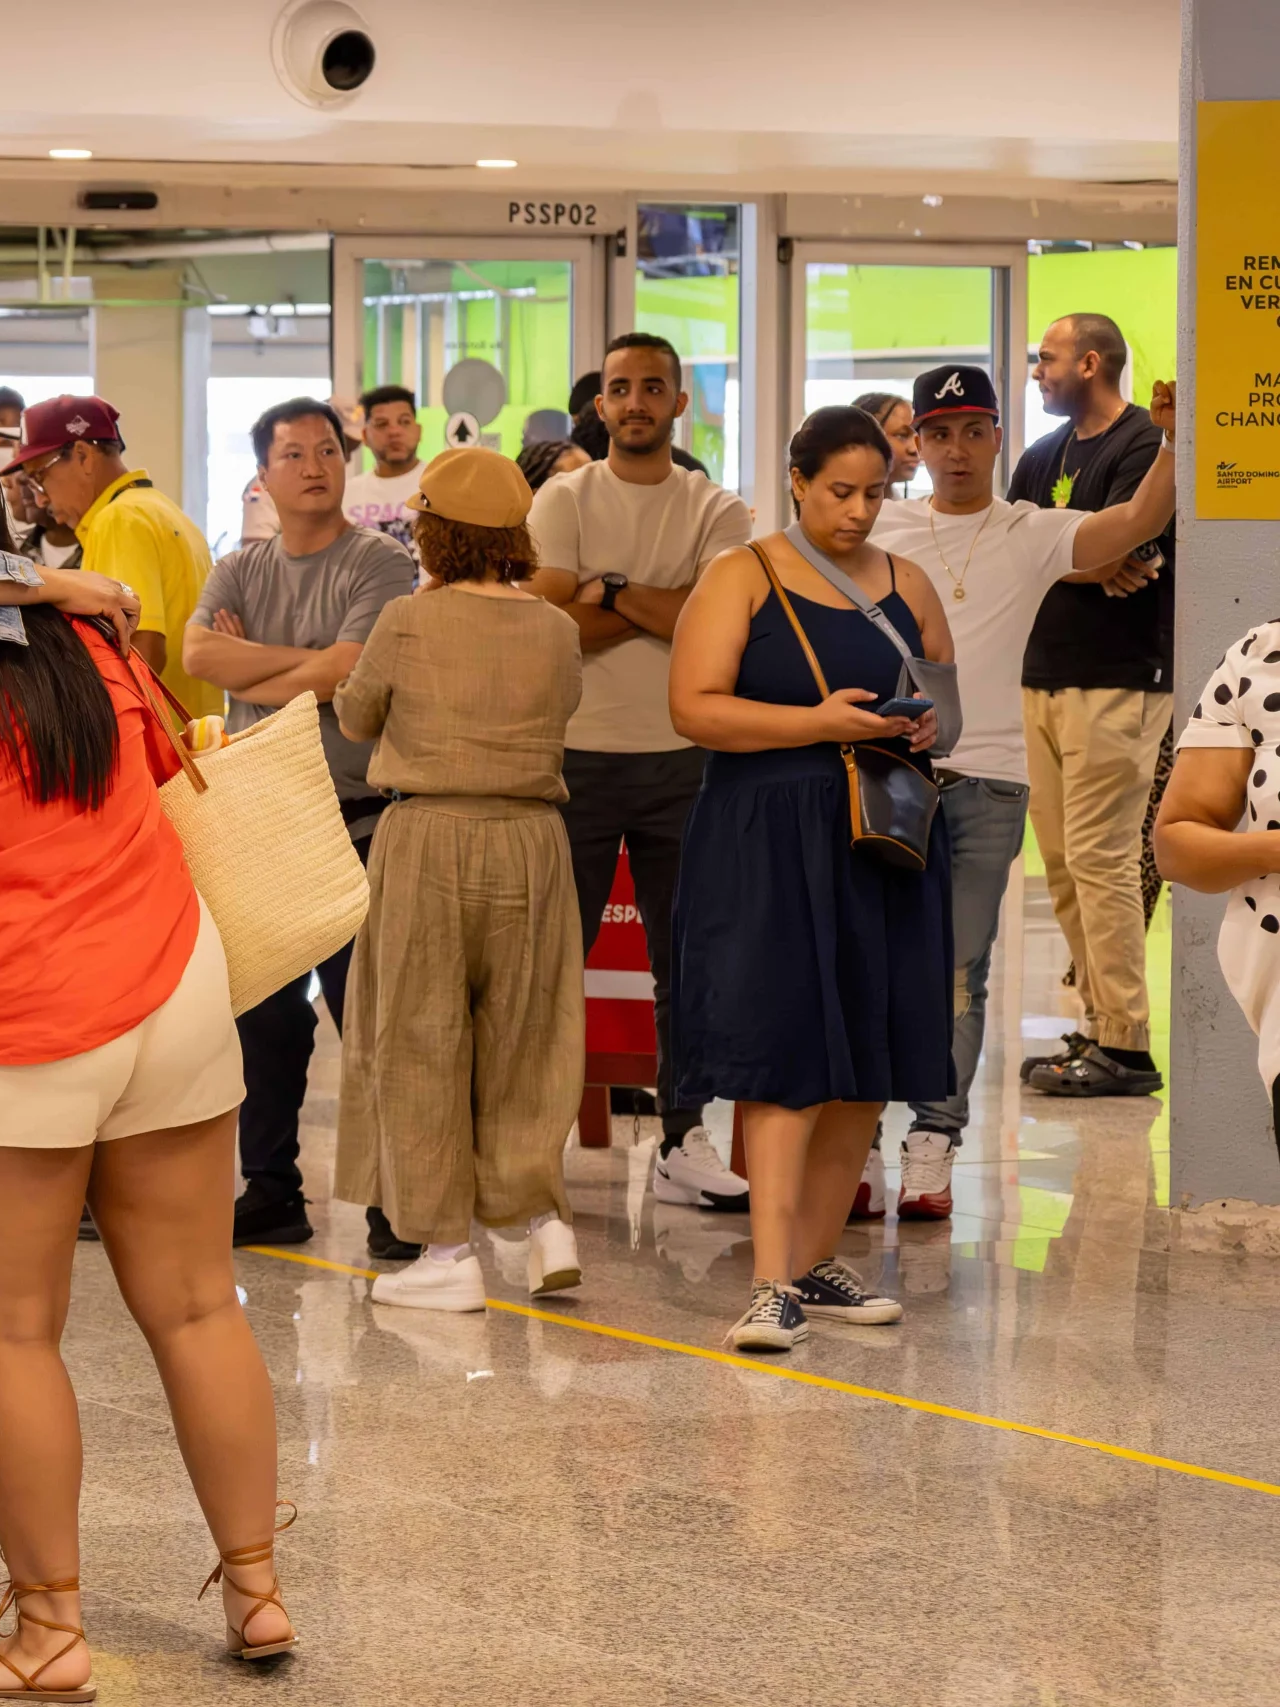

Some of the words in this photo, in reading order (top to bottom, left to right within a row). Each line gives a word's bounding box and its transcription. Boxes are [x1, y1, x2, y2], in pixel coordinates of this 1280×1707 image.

[508, 202, 597, 226] PSSP02
[1225, 275, 1253, 291] EN
[1240, 294, 1280, 310] VER
[1248, 392, 1280, 407] PR
[1215, 411, 1280, 427] CHAN
